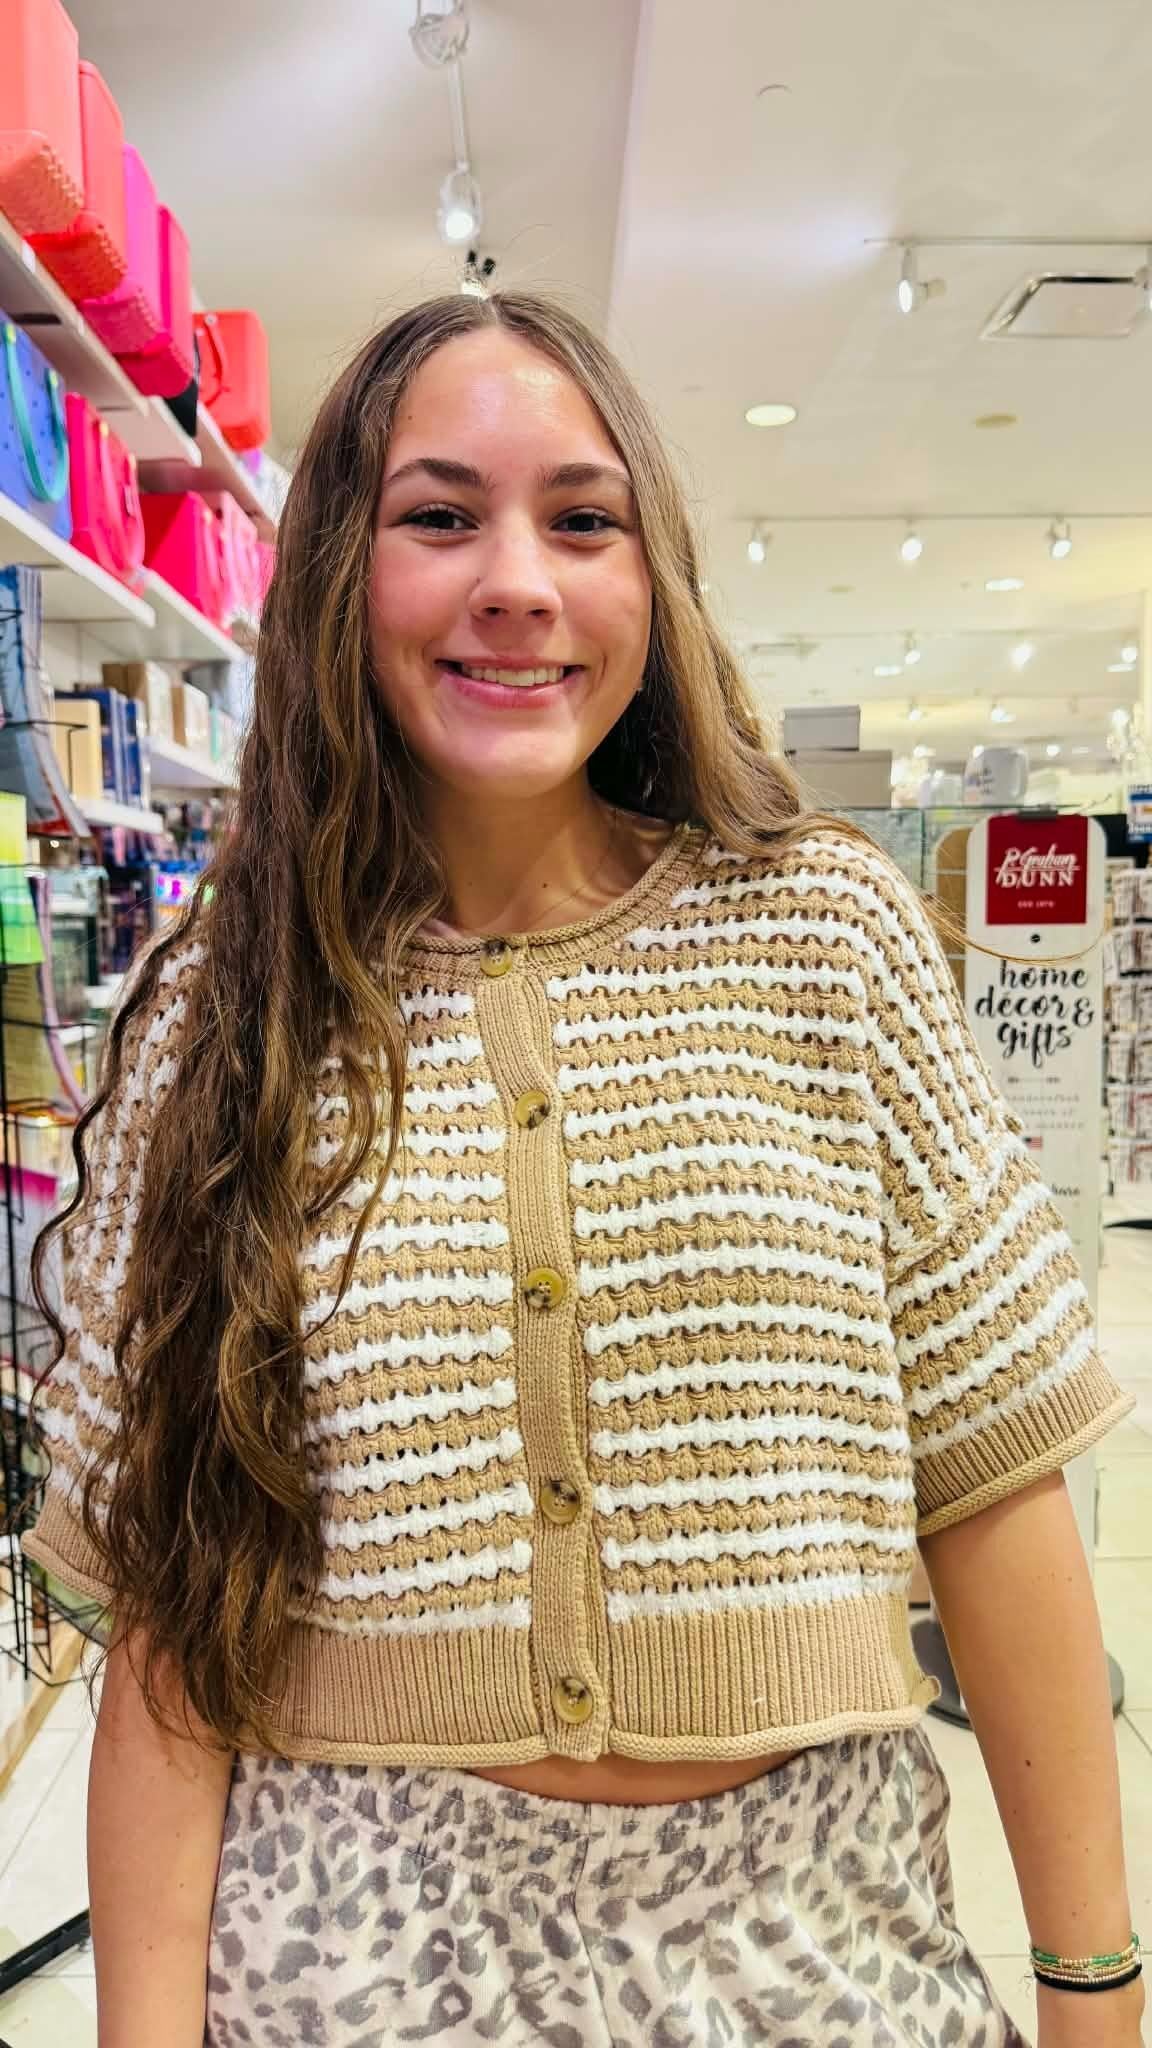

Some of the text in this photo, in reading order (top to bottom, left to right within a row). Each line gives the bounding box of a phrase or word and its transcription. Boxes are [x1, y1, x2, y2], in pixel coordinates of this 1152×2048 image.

[999, 870, 1075, 889] DUNN
[1000, 959, 1088, 989] home
[1072, 996, 1094, 1028] &
[997, 1021, 1071, 1069] gifts
